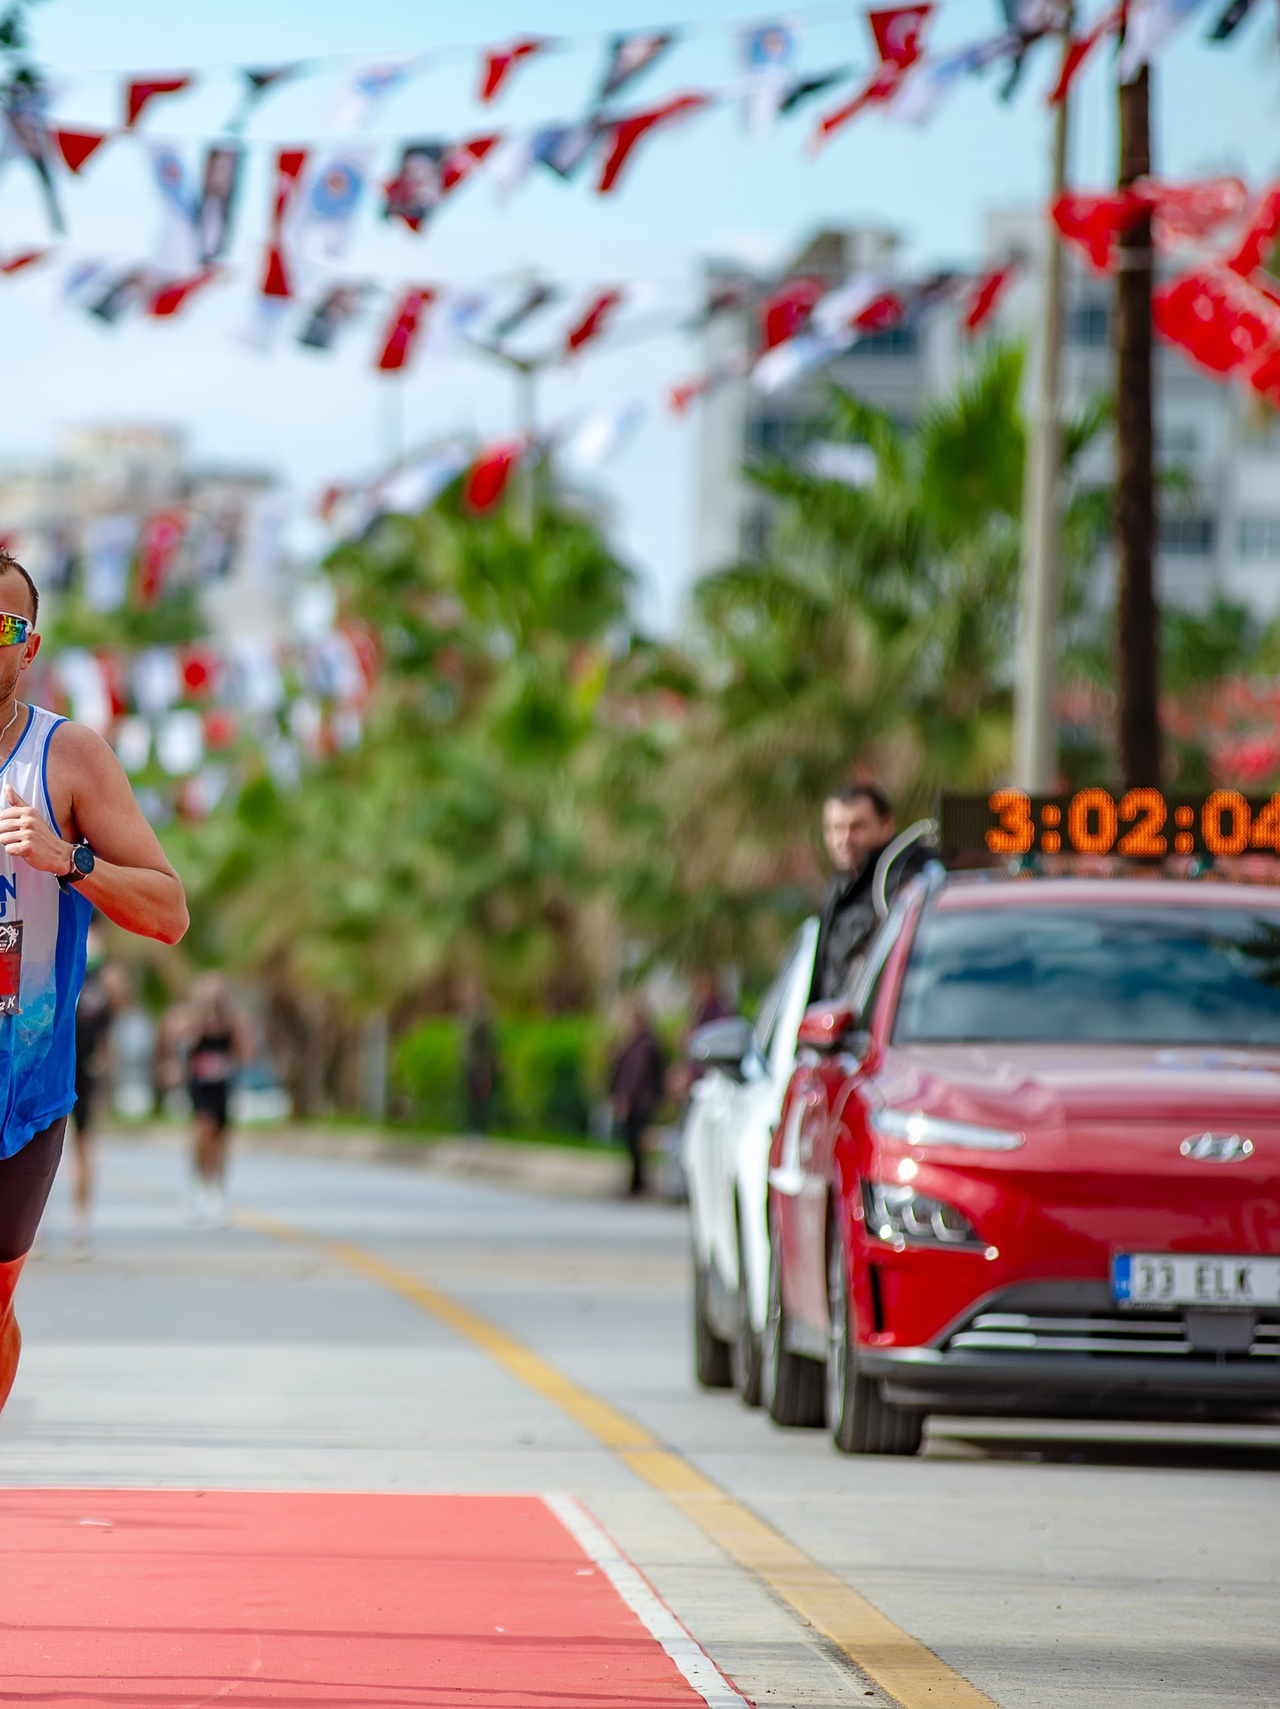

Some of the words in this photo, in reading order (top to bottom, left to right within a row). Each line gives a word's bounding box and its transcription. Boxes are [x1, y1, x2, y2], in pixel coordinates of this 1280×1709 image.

[985, 787, 1280, 857] 3:02:04
[7, 996, 16, 1009] K
[1137, 1262, 1174, 1297] 33
[1193, 1263, 1255, 1299] ELK
